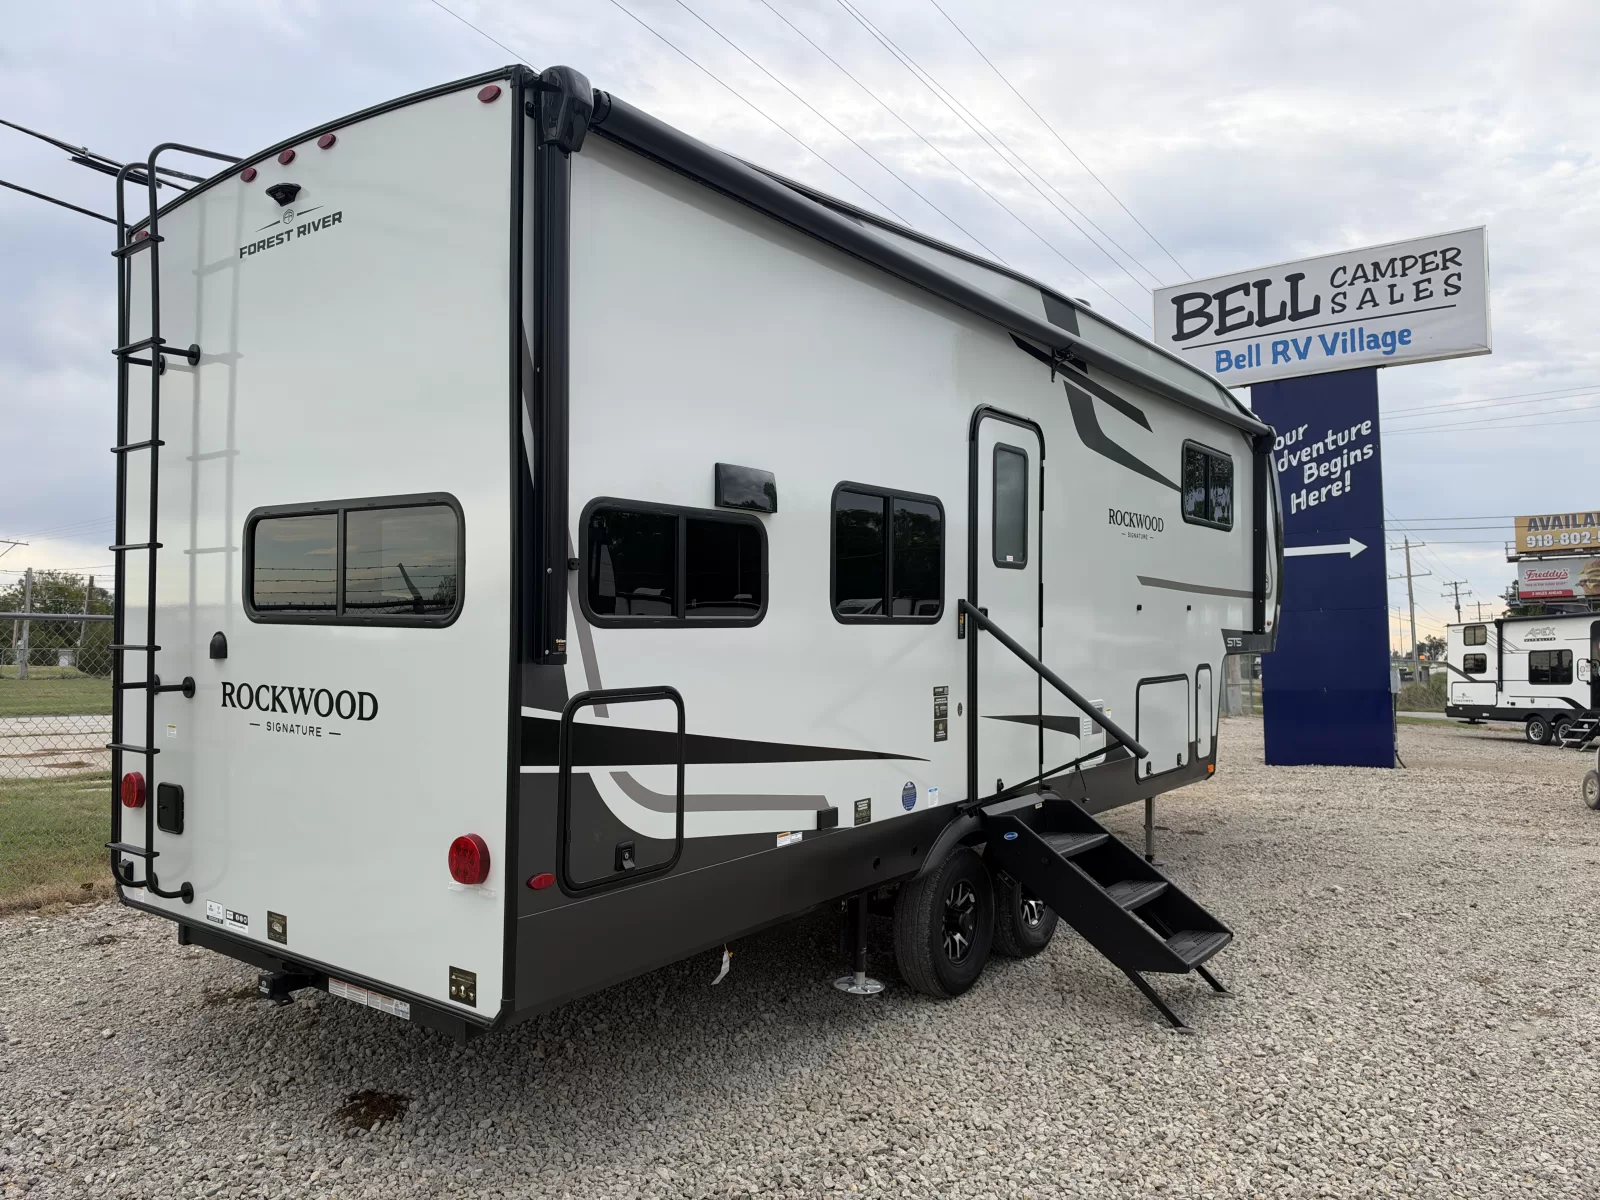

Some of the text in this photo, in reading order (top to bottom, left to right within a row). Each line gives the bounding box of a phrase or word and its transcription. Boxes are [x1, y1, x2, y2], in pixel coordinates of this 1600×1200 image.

[240, 211, 343, 259] FOREST RIVER
[1171, 246, 1463, 342] BELL CAMPER
[1331, 272, 1462, 315] SALES
[1215, 326, 1412, 373] Bell RV Village
[1273, 423, 1309, 451] our
[1277, 420, 1372, 472] dventure
[1303, 443, 1374, 484] Begins
[1290, 470, 1351, 515] Here!
[1108, 508, 1164, 532] ROCKWOOD
[1127, 532, 1149, 540] SIGNATURE
[1524, 568, 1569, 581] Freddy's
[1226, 637, 1243, 647] STS
[1525, 627, 1556, 637] APEX
[221, 681, 379, 721] ROCKWOOD
[266, 721, 322, 737] SIGNATURE
